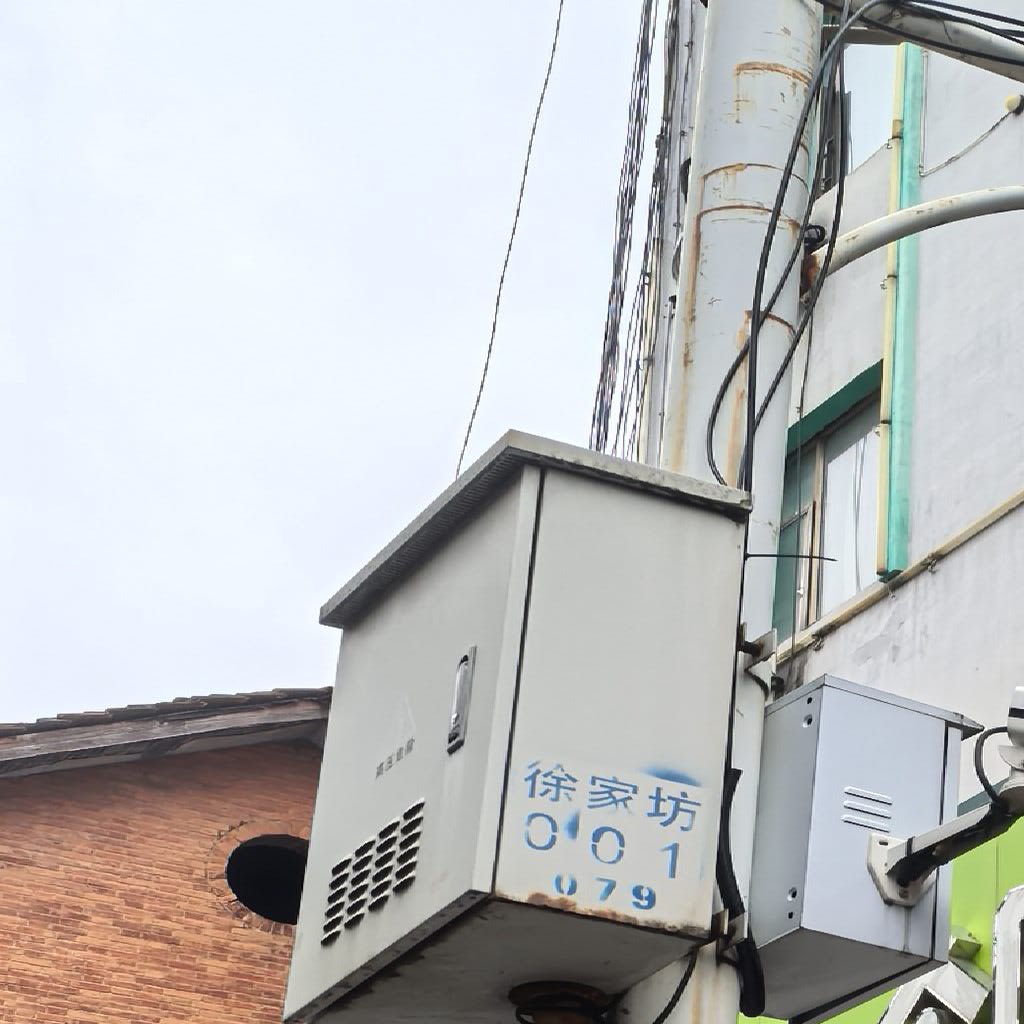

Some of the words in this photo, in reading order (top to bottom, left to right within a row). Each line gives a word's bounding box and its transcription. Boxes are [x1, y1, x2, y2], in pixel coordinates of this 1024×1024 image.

[523, 760, 701, 832] 徐家坊
[524, 812, 680, 879] 001
[554, 872, 657, 910] 079
